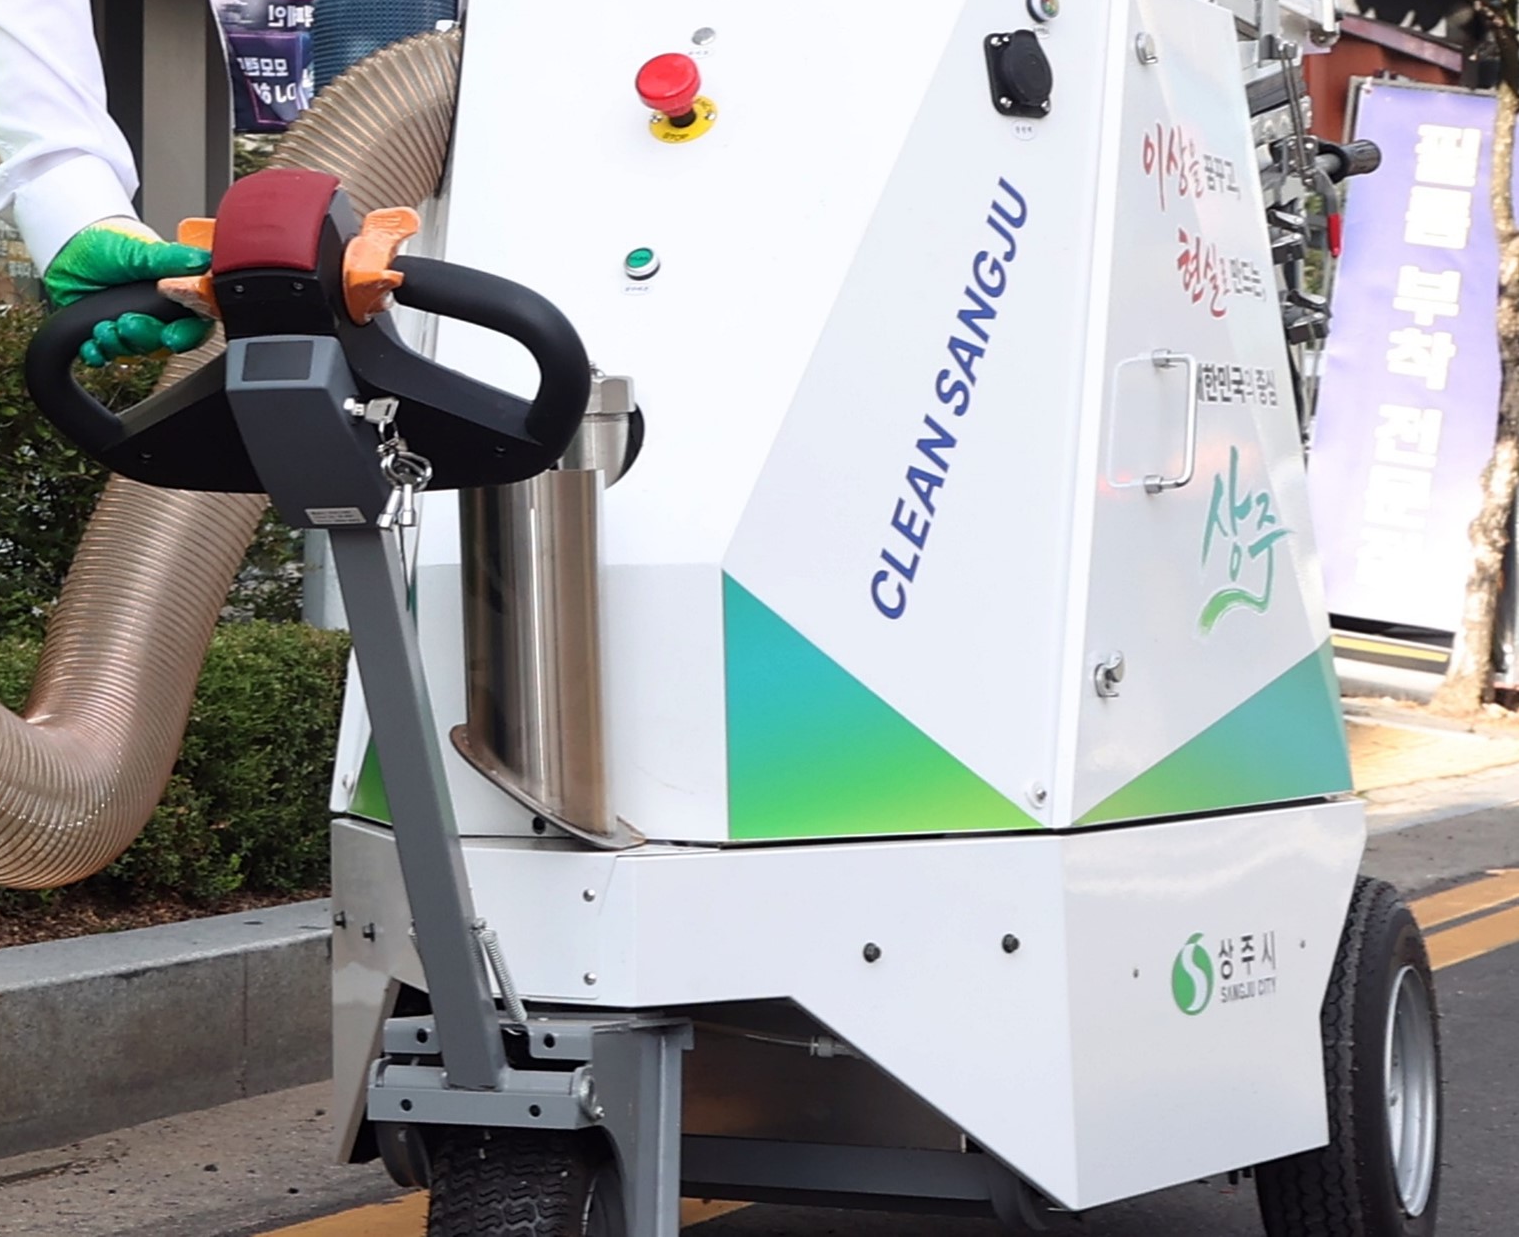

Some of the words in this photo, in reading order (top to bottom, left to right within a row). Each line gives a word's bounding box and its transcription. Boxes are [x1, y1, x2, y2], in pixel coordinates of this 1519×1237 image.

[1143, 122, 1204, 212] 이상을
[870, 413, 958, 620] CLEAN
[935, 176, 1028, 417] SANGJU
[1255, 369, 1278, 407] 중심
[1197, 445, 1297, 637] 상주
[1218, 930, 1276, 980] 상주시
[1220, 981, 1256, 1004] SANGJU
[1258, 977, 1277, 996] CITY
